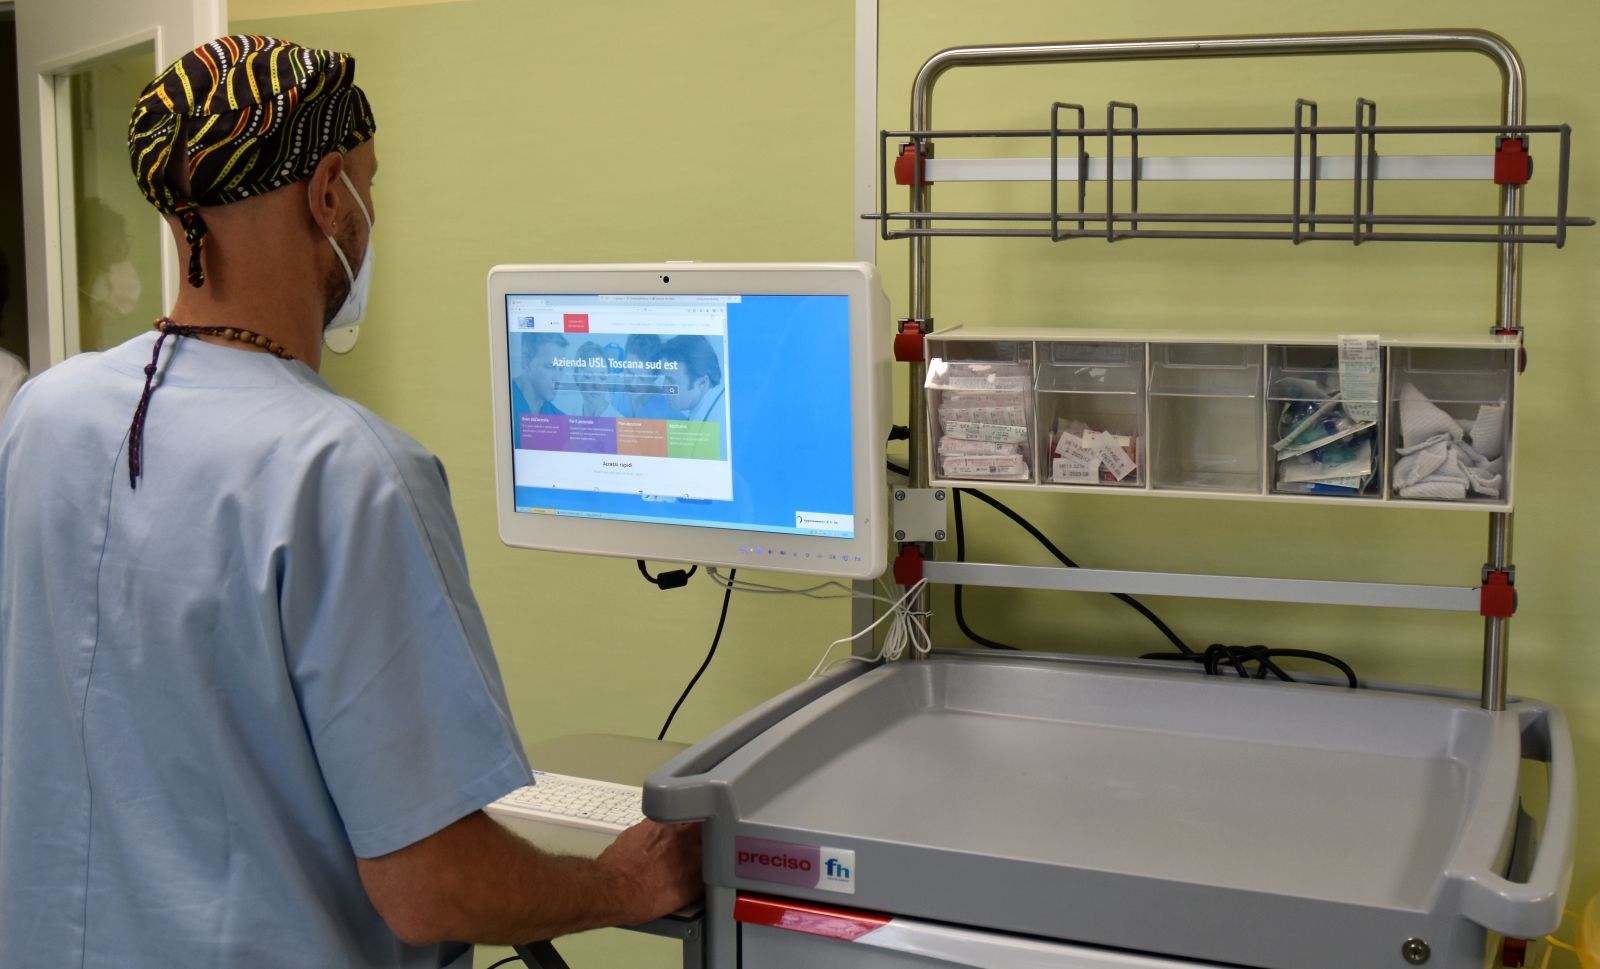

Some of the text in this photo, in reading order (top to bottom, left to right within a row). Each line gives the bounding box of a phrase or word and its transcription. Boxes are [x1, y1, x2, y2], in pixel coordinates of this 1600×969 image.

[553, 357, 678, 370] Azienda USL Toscana sud est
[737, 850, 812, 871] preciso
[824, 858, 850, 879] fh
